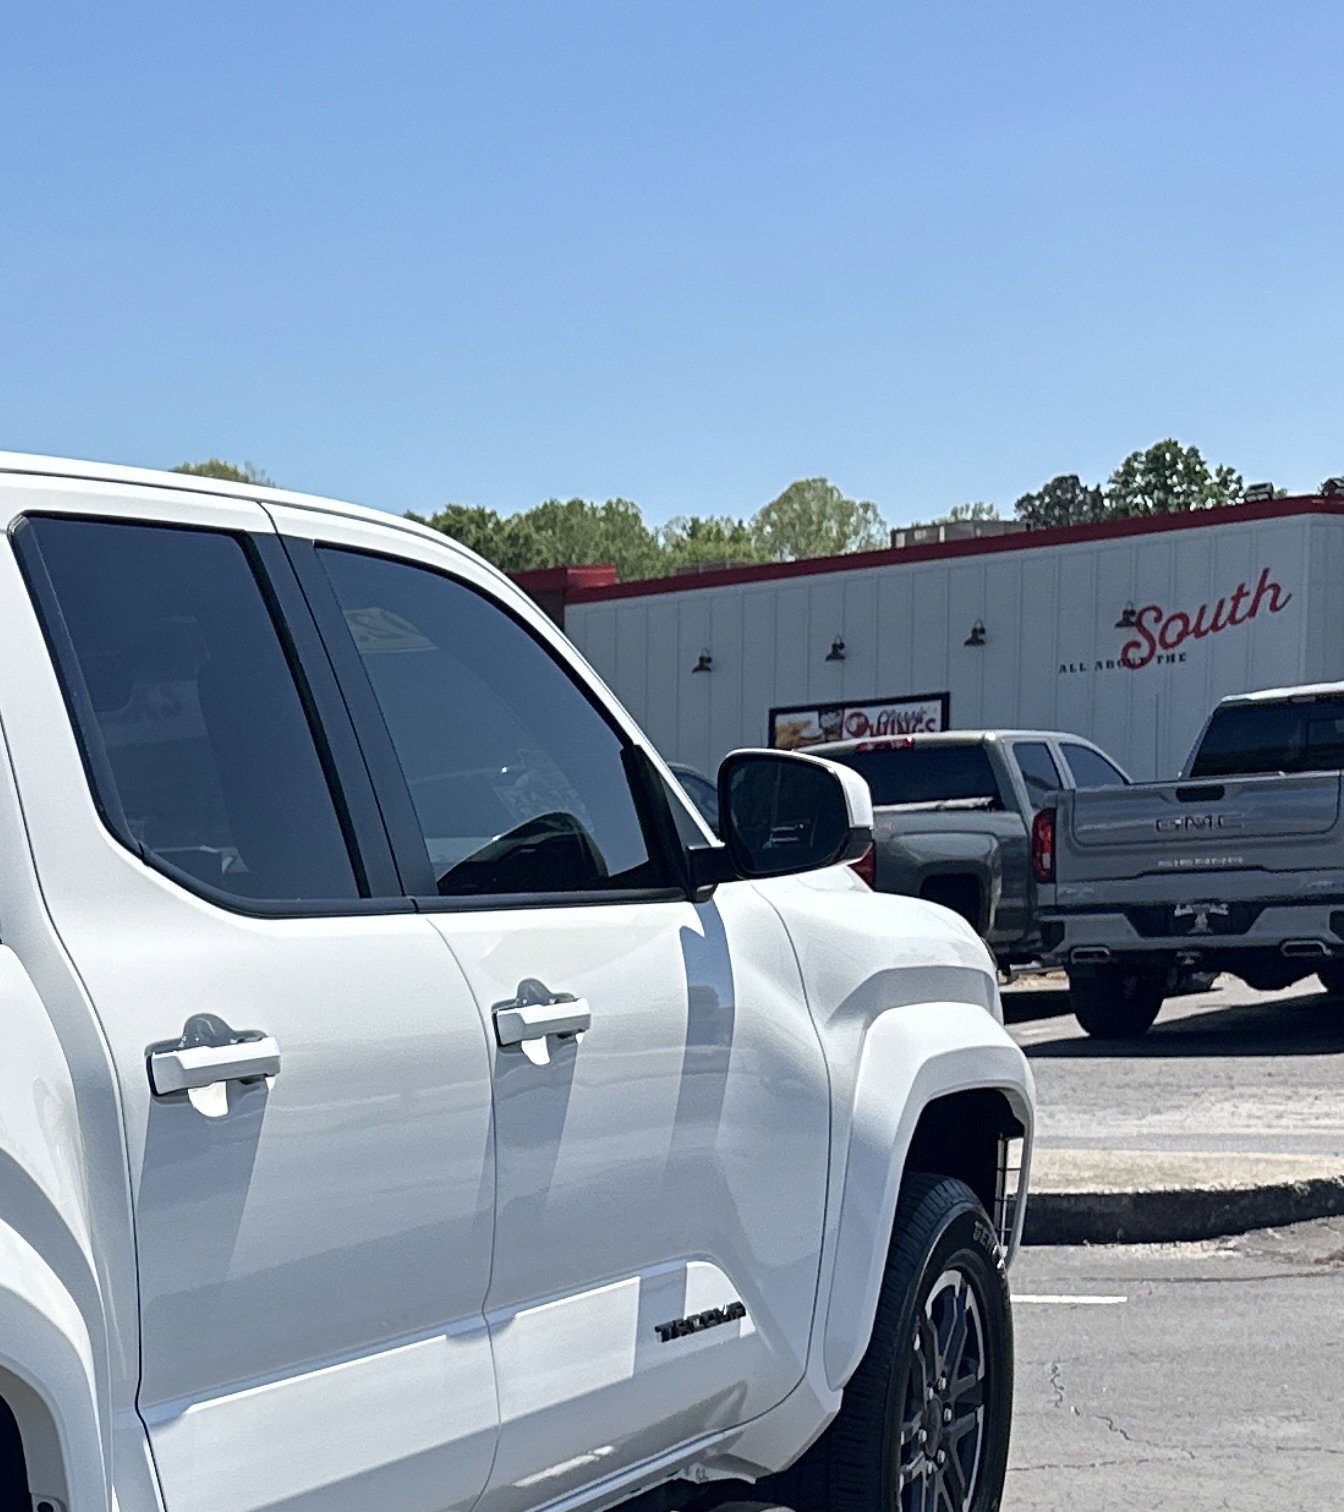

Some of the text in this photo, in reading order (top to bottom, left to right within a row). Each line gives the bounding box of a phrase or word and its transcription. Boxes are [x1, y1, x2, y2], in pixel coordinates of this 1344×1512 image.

[1120, 567, 1292, 670] South
[1058, 662, 1087, 674] ALL
[1156, 652, 1188, 665] THE
[1155, 811, 1245, 832] GMC
